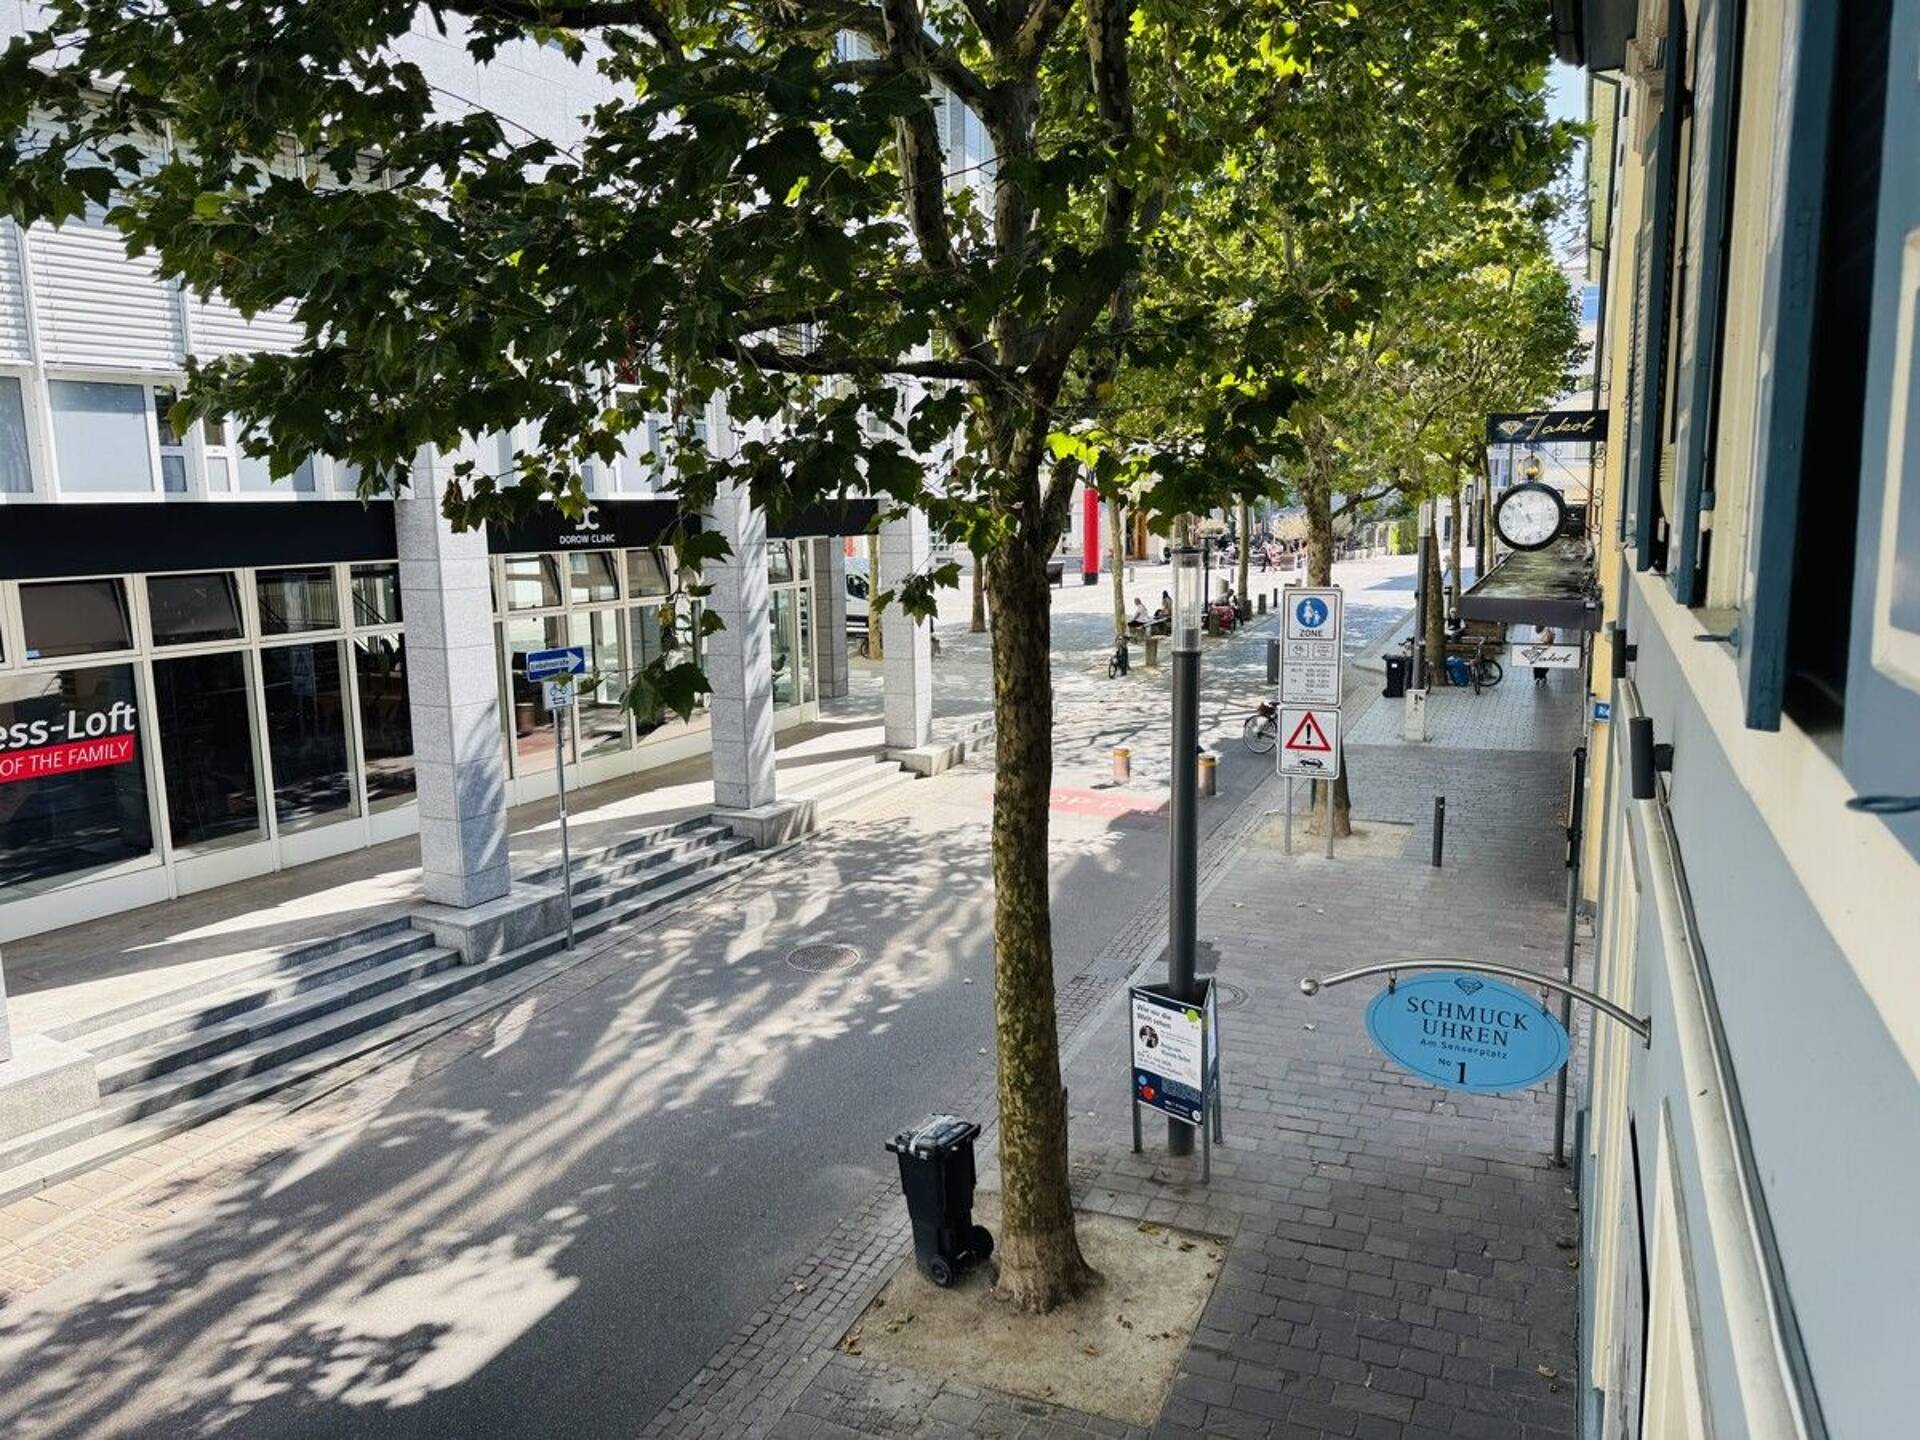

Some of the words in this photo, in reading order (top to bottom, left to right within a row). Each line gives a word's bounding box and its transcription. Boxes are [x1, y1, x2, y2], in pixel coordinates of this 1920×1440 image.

[559, 535, 590, 544] DOROW
[591, 534, 616, 543] CLINIC
[1299, 629, 1323, 638] ZONE
[0, 756, 25, 777] OF
[29, 752, 63, 772] THE
[68, 740, 129, 765] FAMILY
[1407, 996, 1528, 1031] SCHMUCK
[1420, 1038, 1437, 1048] Am
[1423, 1018, 1509, 1047] UHREN
[1456, 1062, 1467, 1085] 1
